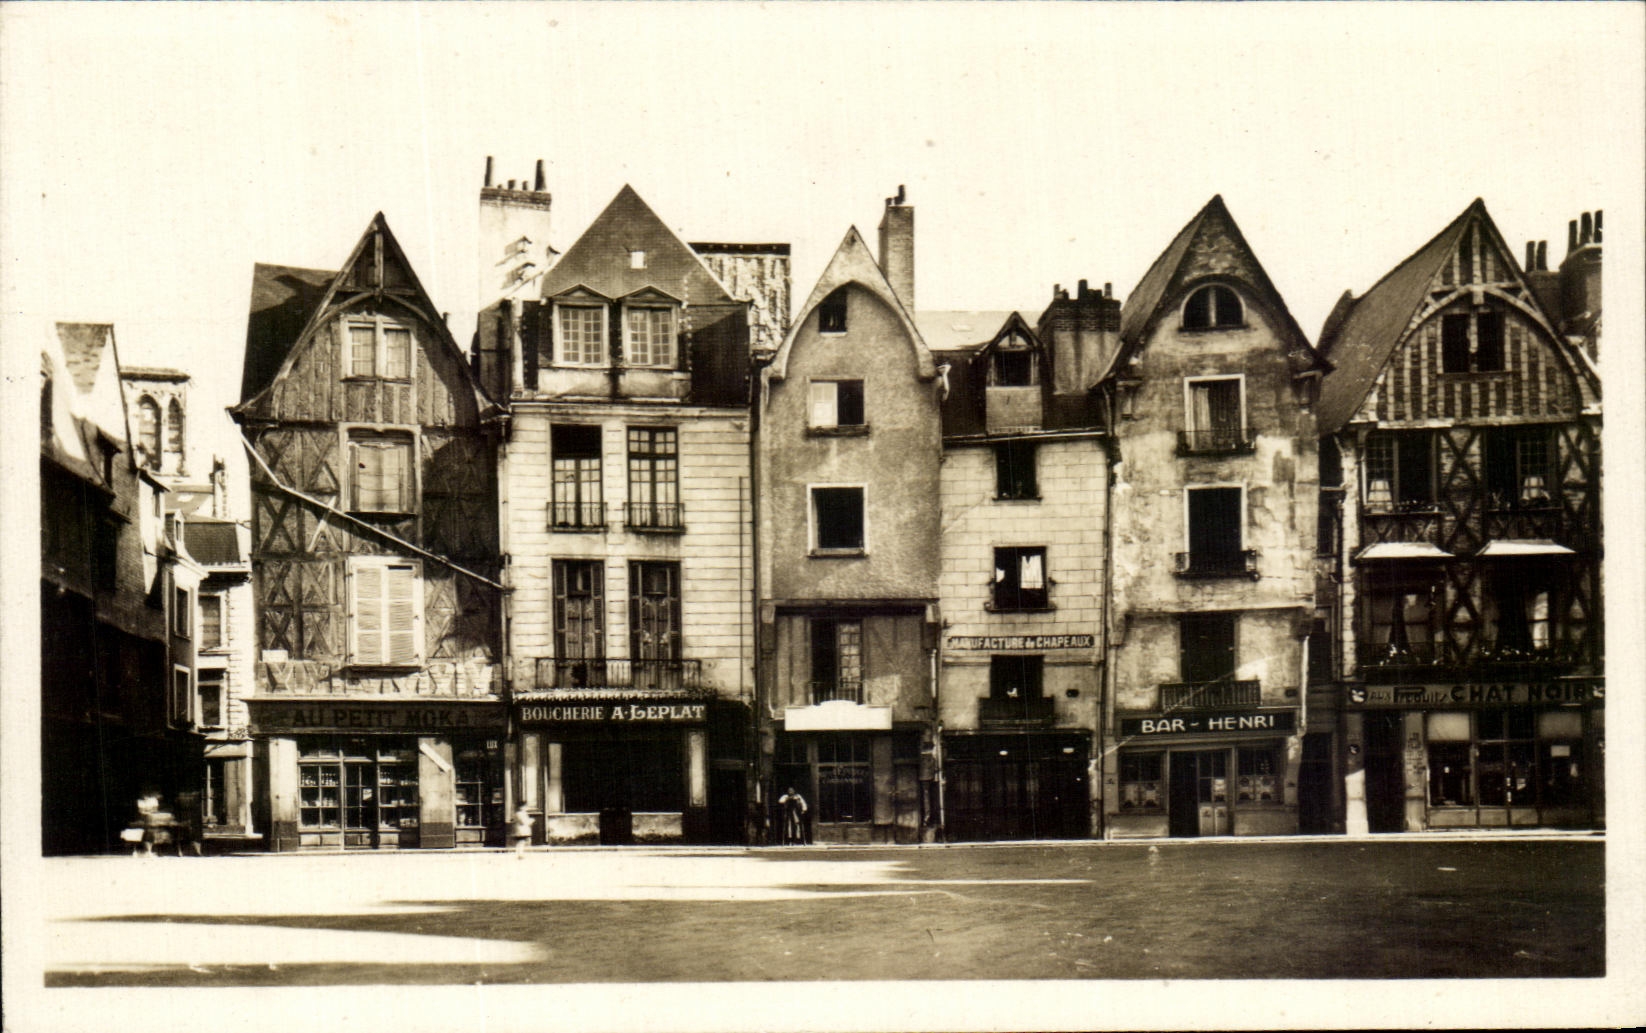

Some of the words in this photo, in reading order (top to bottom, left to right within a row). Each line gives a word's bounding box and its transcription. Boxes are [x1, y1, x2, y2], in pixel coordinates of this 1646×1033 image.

[952, 637, 1024, 648] MANUFACTURE
[1036, 636, 1090, 648] CHAPEAUX
[1451, 685, 1515, 702] CHAT
[1527, 684, 1586, 702] NOIR
[292, 709, 323, 727] AU
[334, 708, 398, 727] PETIT
[405, 708, 470, 728] MOKA
[522, 706, 604, 721] BOUCHERIE
[1141, 718, 1186, 733] BAR
[1208, 715, 1274, 730] HENRI
